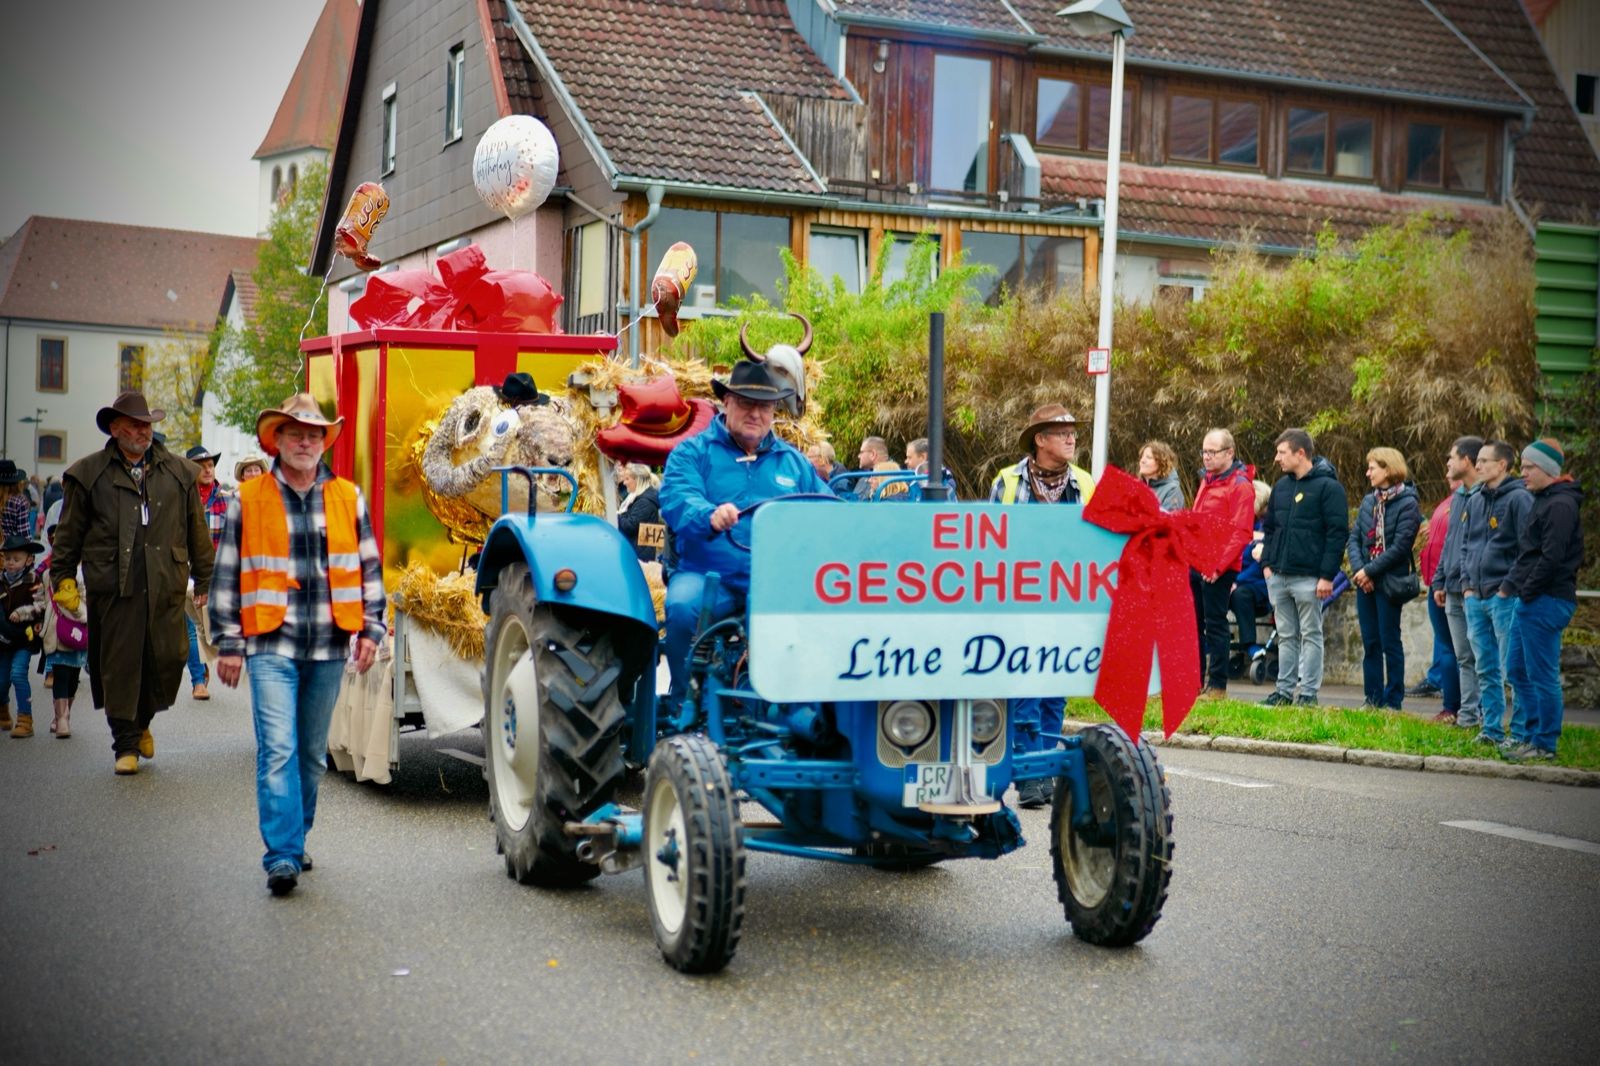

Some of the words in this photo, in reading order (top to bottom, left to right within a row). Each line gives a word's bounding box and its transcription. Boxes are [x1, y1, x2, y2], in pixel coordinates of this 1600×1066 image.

[932, 513, 1008, 550] EIN
[814, 561, 1119, 604] GESCHENK
[838, 637, 942, 680] Line
[961, 634, 1101, 675] Dance
[922, 766, 946, 785] CR
